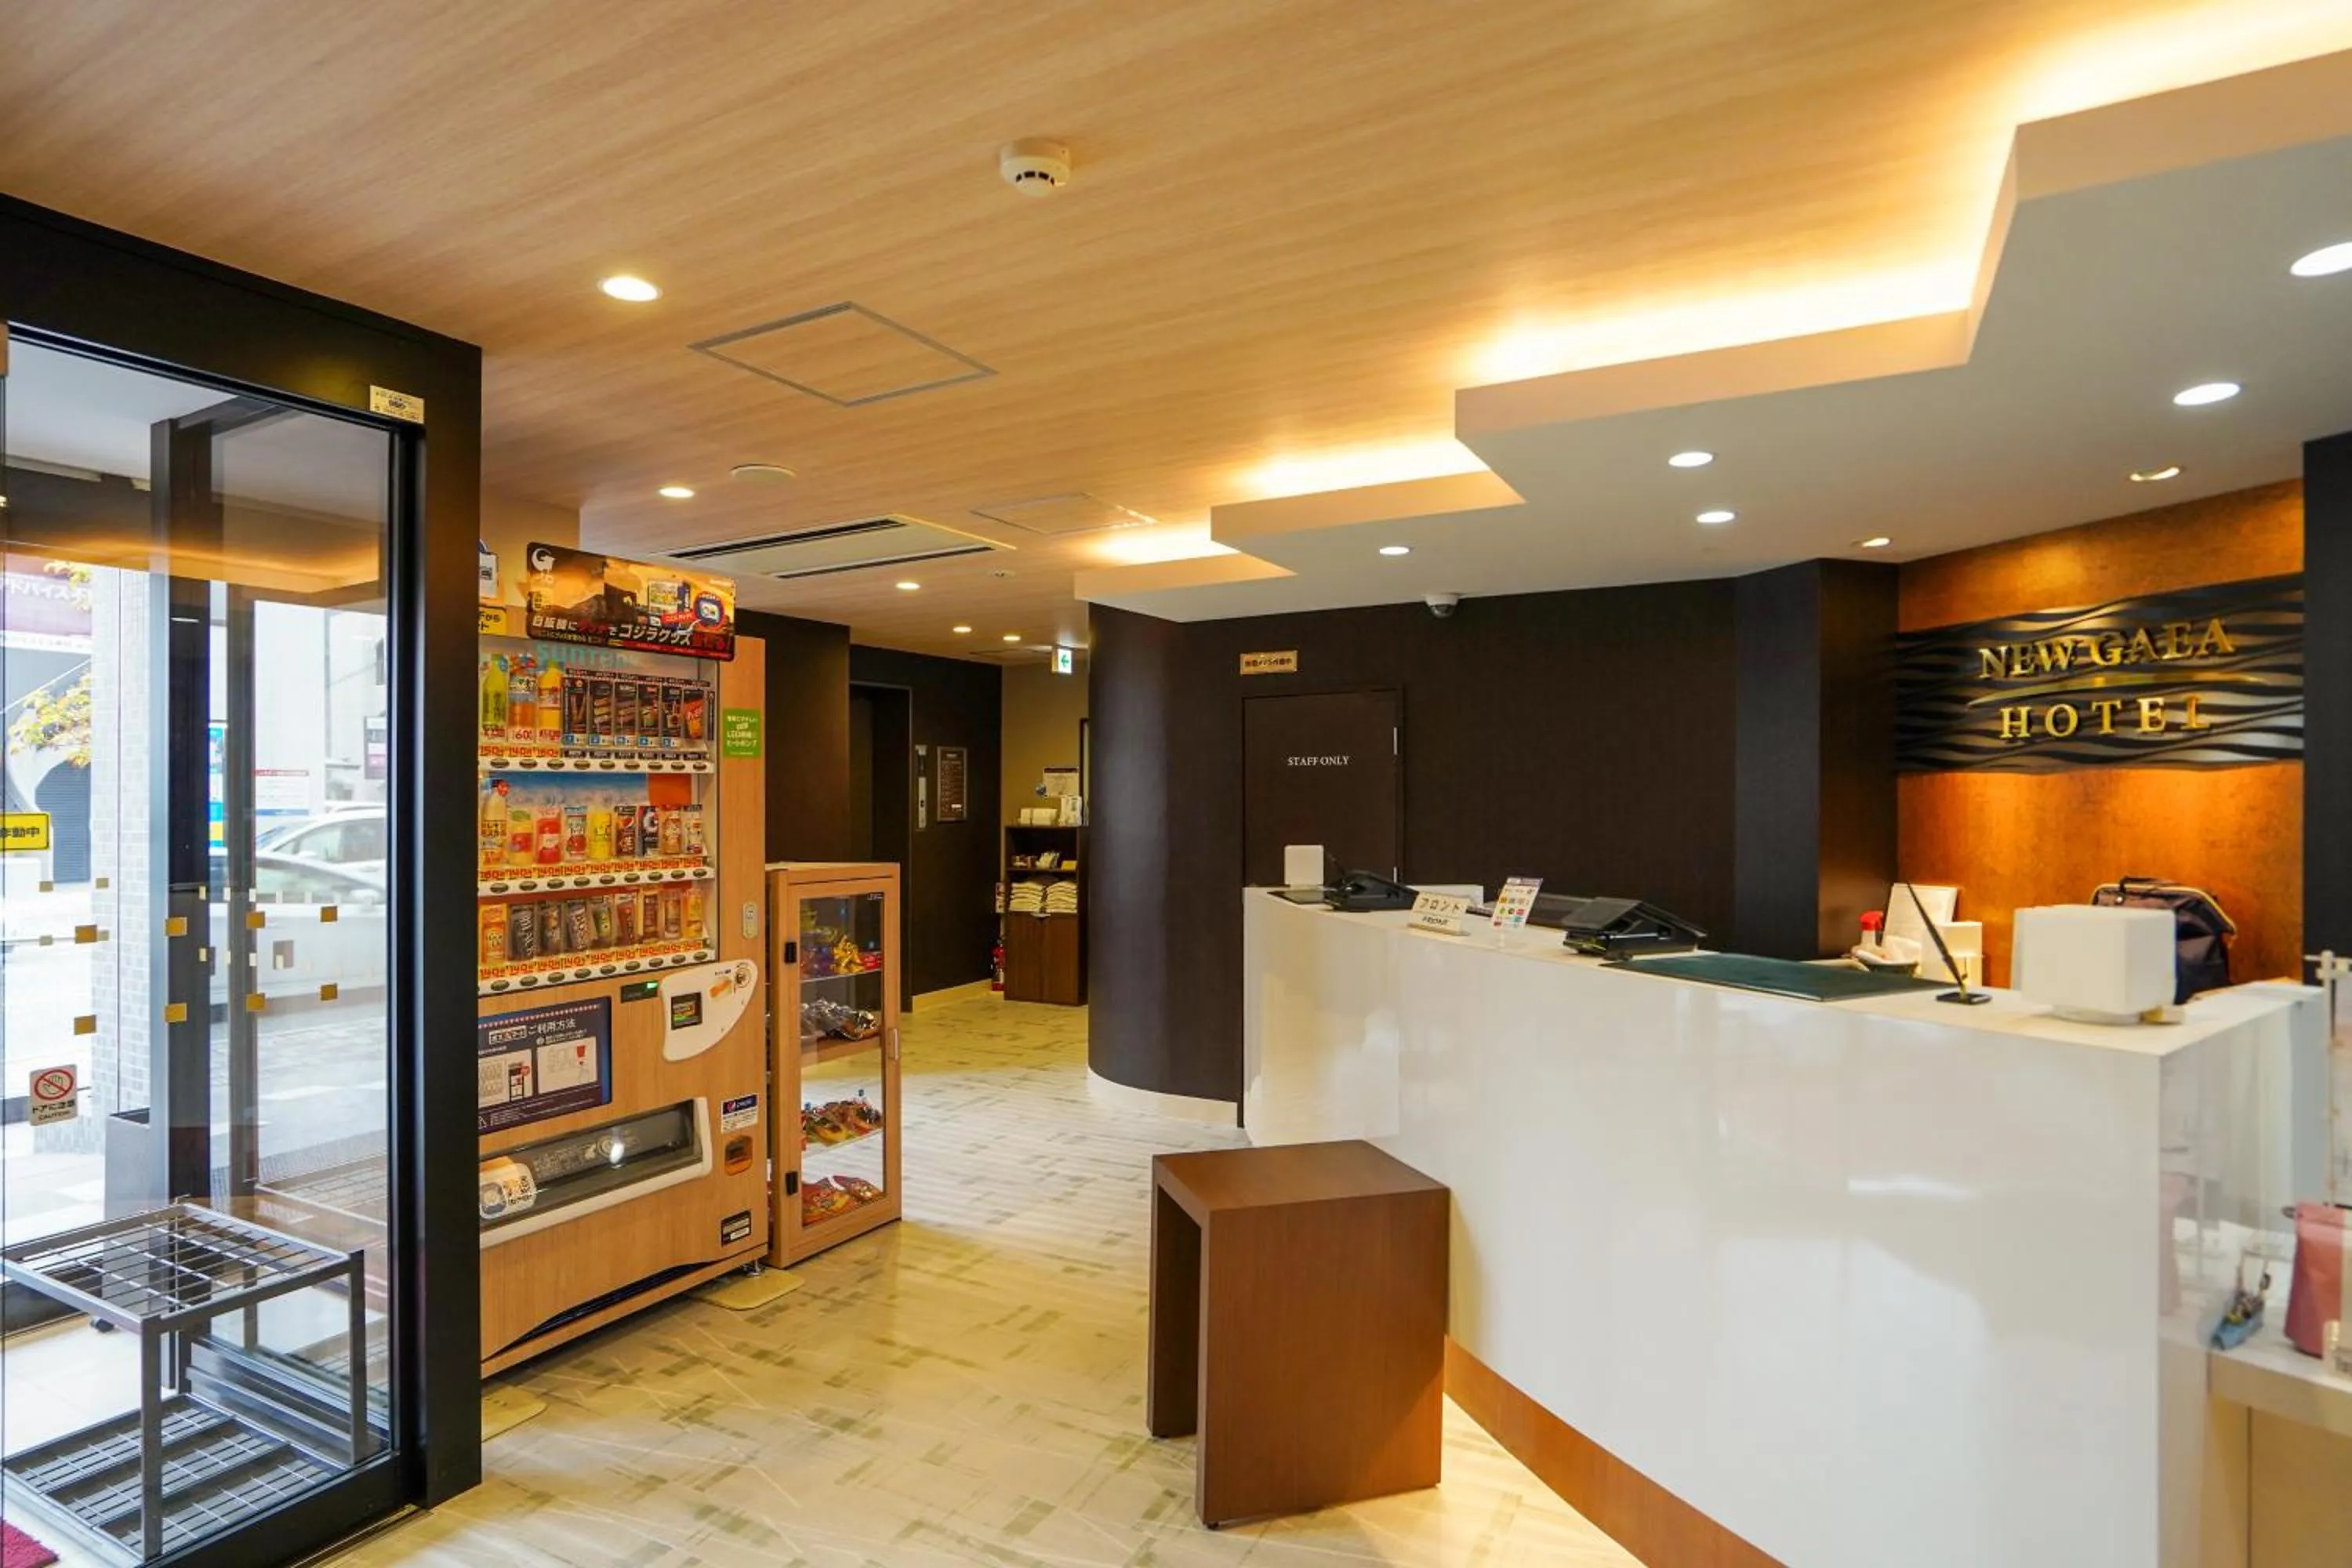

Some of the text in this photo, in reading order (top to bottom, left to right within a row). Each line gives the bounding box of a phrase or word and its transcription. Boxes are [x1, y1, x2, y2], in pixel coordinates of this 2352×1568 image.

[1978, 617, 2236, 679] NEW GAEA
[1999, 695, 2210, 740] HOTEL
[1287, 756, 1350, 766] STAFF ONLY
[1418, 897, 1461, 915] フロント
